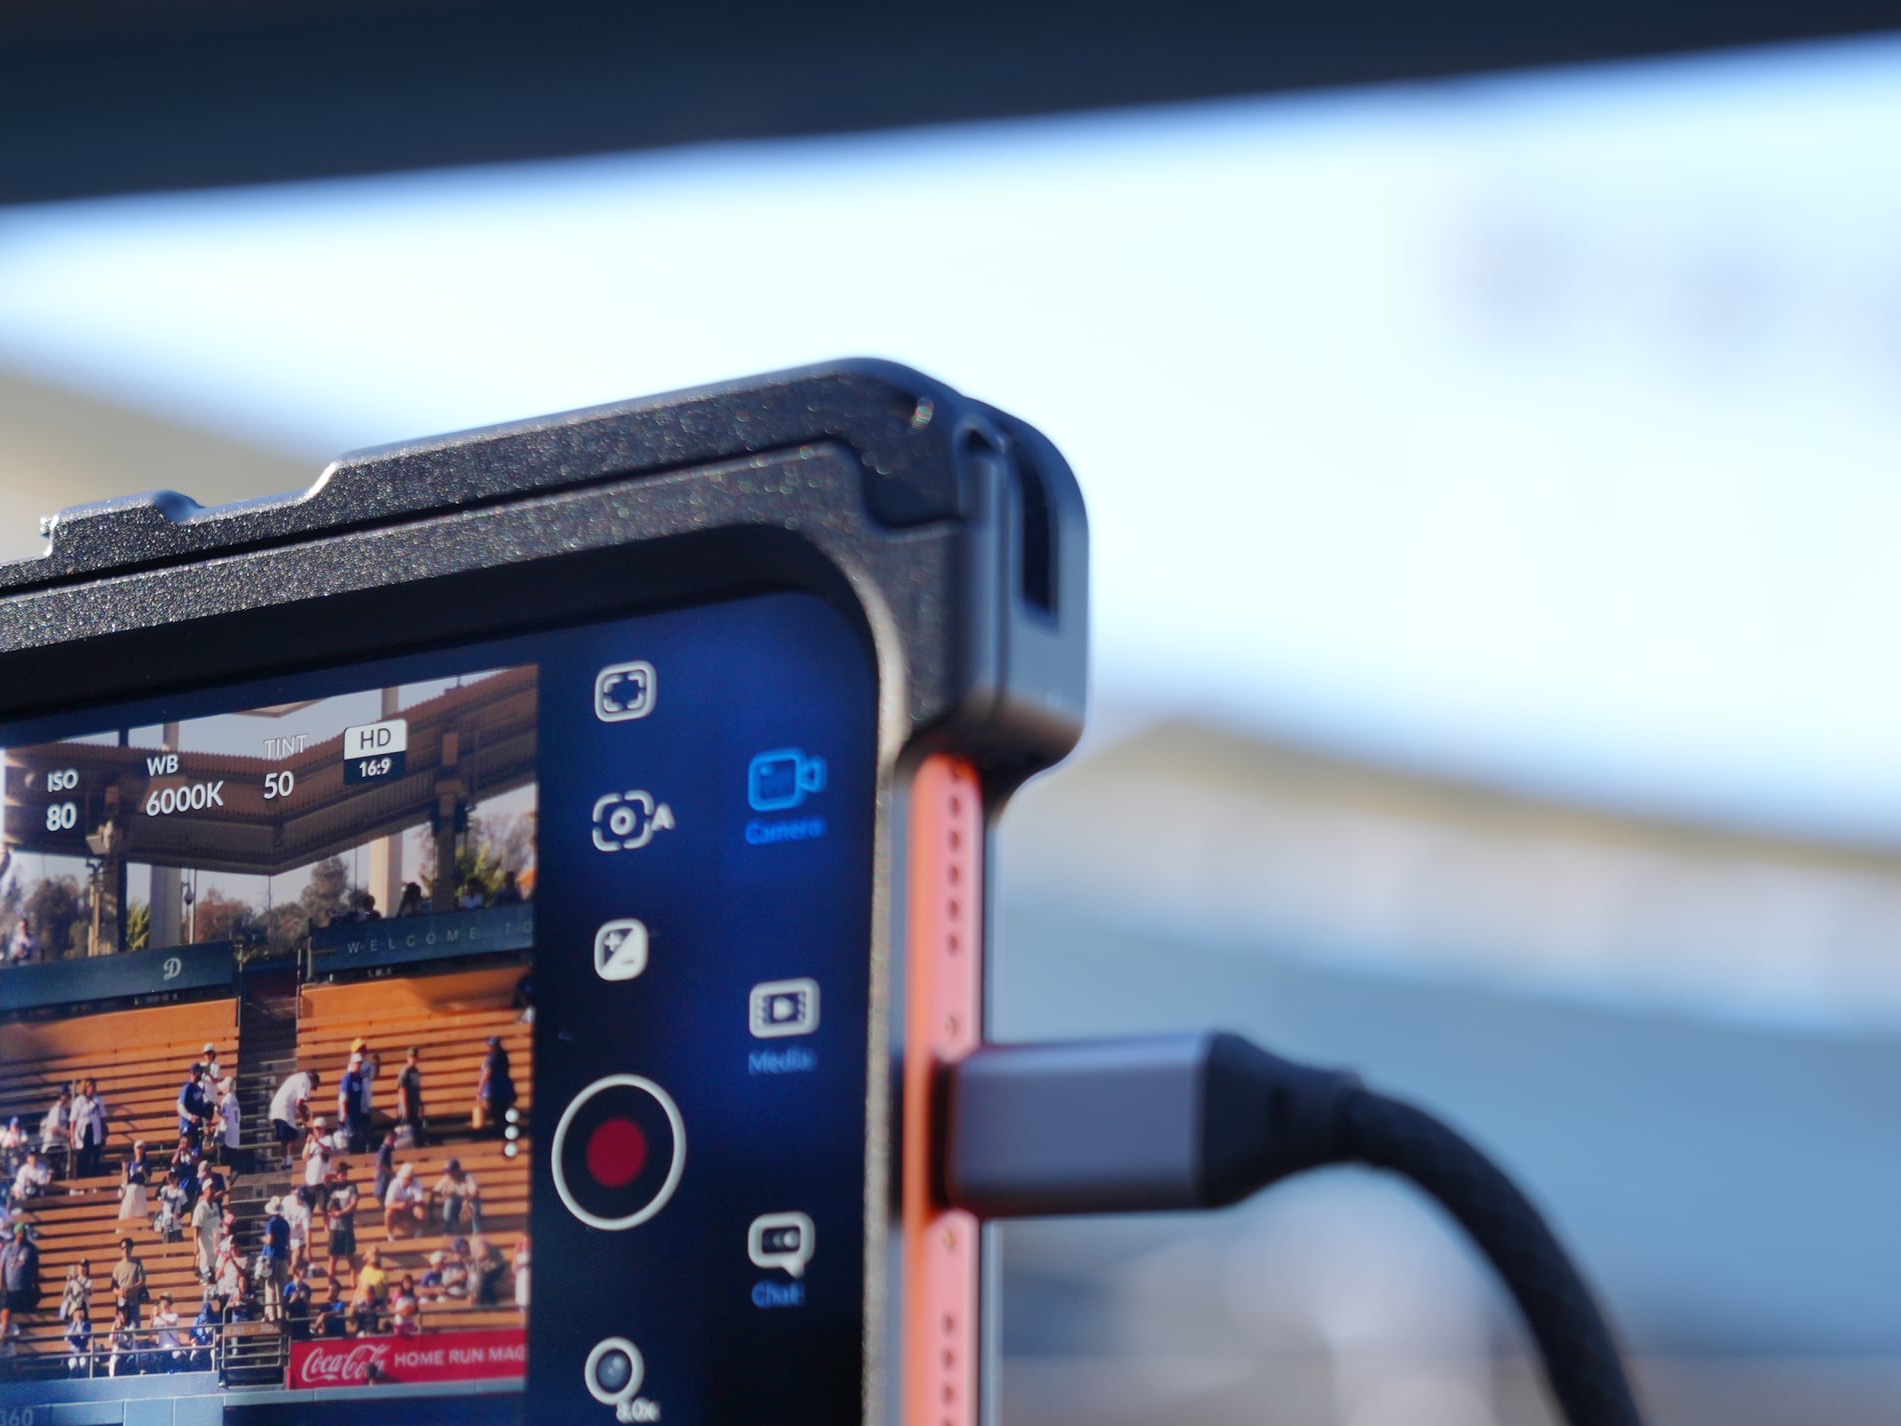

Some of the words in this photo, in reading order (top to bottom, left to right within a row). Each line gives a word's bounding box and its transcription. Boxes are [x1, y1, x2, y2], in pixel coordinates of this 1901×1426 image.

[263, 733, 309, 760] TINT
[359, 727, 392, 751] HD
[146, 754, 180, 777] WB
[358, 757, 392, 779] 16:9
[47, 768, 80, 793] ISO
[263, 771, 295, 800] 50
[145, 780, 225, 818] 6000K
[45, 801, 78, 832] 80
[745, 817, 827, 845] Camera
[347, 926, 478, 955] WELCOME
[748, 1045, 817, 1075] Media
[751, 1281, 805, 1309] Chat
[394, 1348, 444, 1368] HOME
[449, 1346, 484, 1364] RUN
